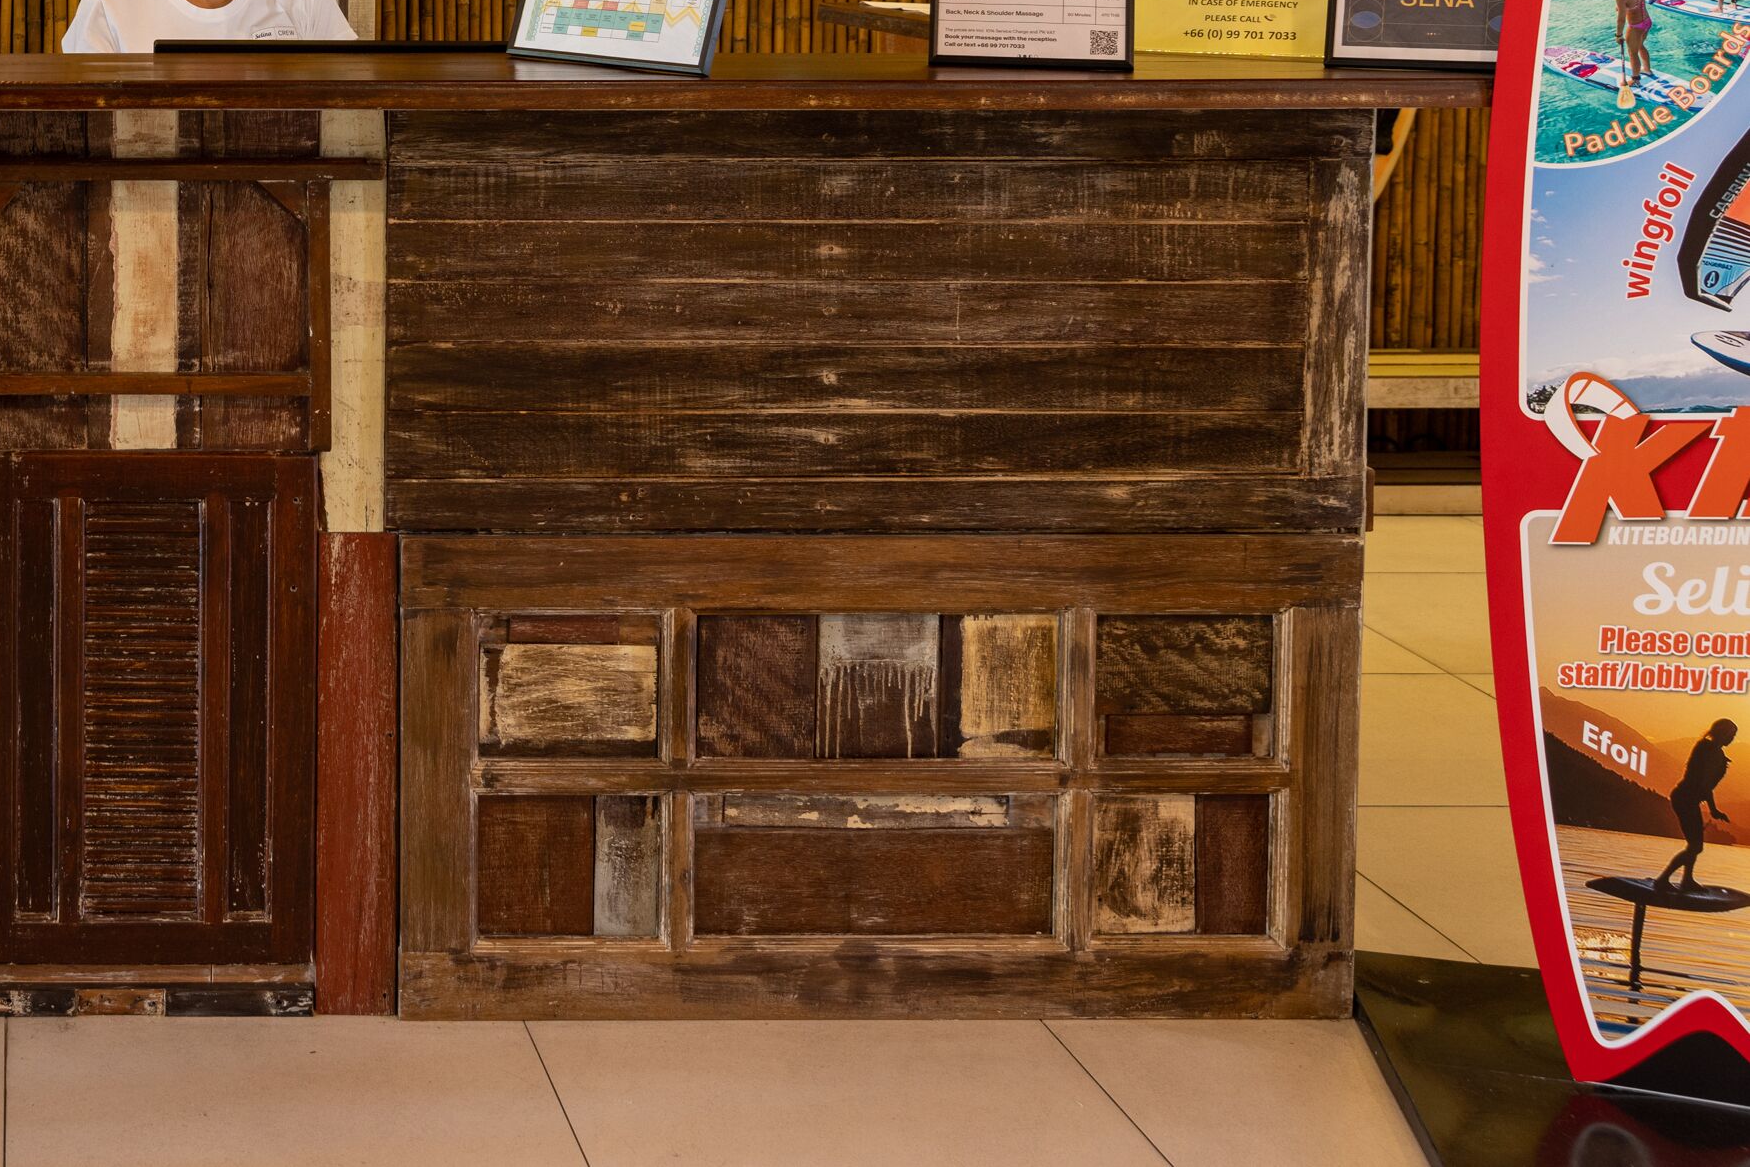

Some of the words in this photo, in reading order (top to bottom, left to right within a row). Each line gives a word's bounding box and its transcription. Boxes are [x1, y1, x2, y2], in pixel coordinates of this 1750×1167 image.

[946, 8, 962, 16] Back,
[1201, 0, 1223, 7] CASE
[1240, 0, 1298, 9] EMERGENCY
[1183, 29, 1204, 38] +66
[1207, 29, 1223, 40] (0)
[1226, 31, 1240, 39] 99
[1244, 31, 1264, 40] 701
[1268, 31, 1297, 40] 7033
[1563, 105, 1674, 157] Paddle
[1666, 22, 1750, 112] Boards
[1709, 161, 1750, 219] CABRIN
[1621, 161, 1697, 300] wingfoil
[1600, 626, 1690, 654] Please
[1559, 661, 1704, 693] staff/lobby
[1709, 665, 1749, 692] for
[1582, 721, 1648, 777] Efoil
